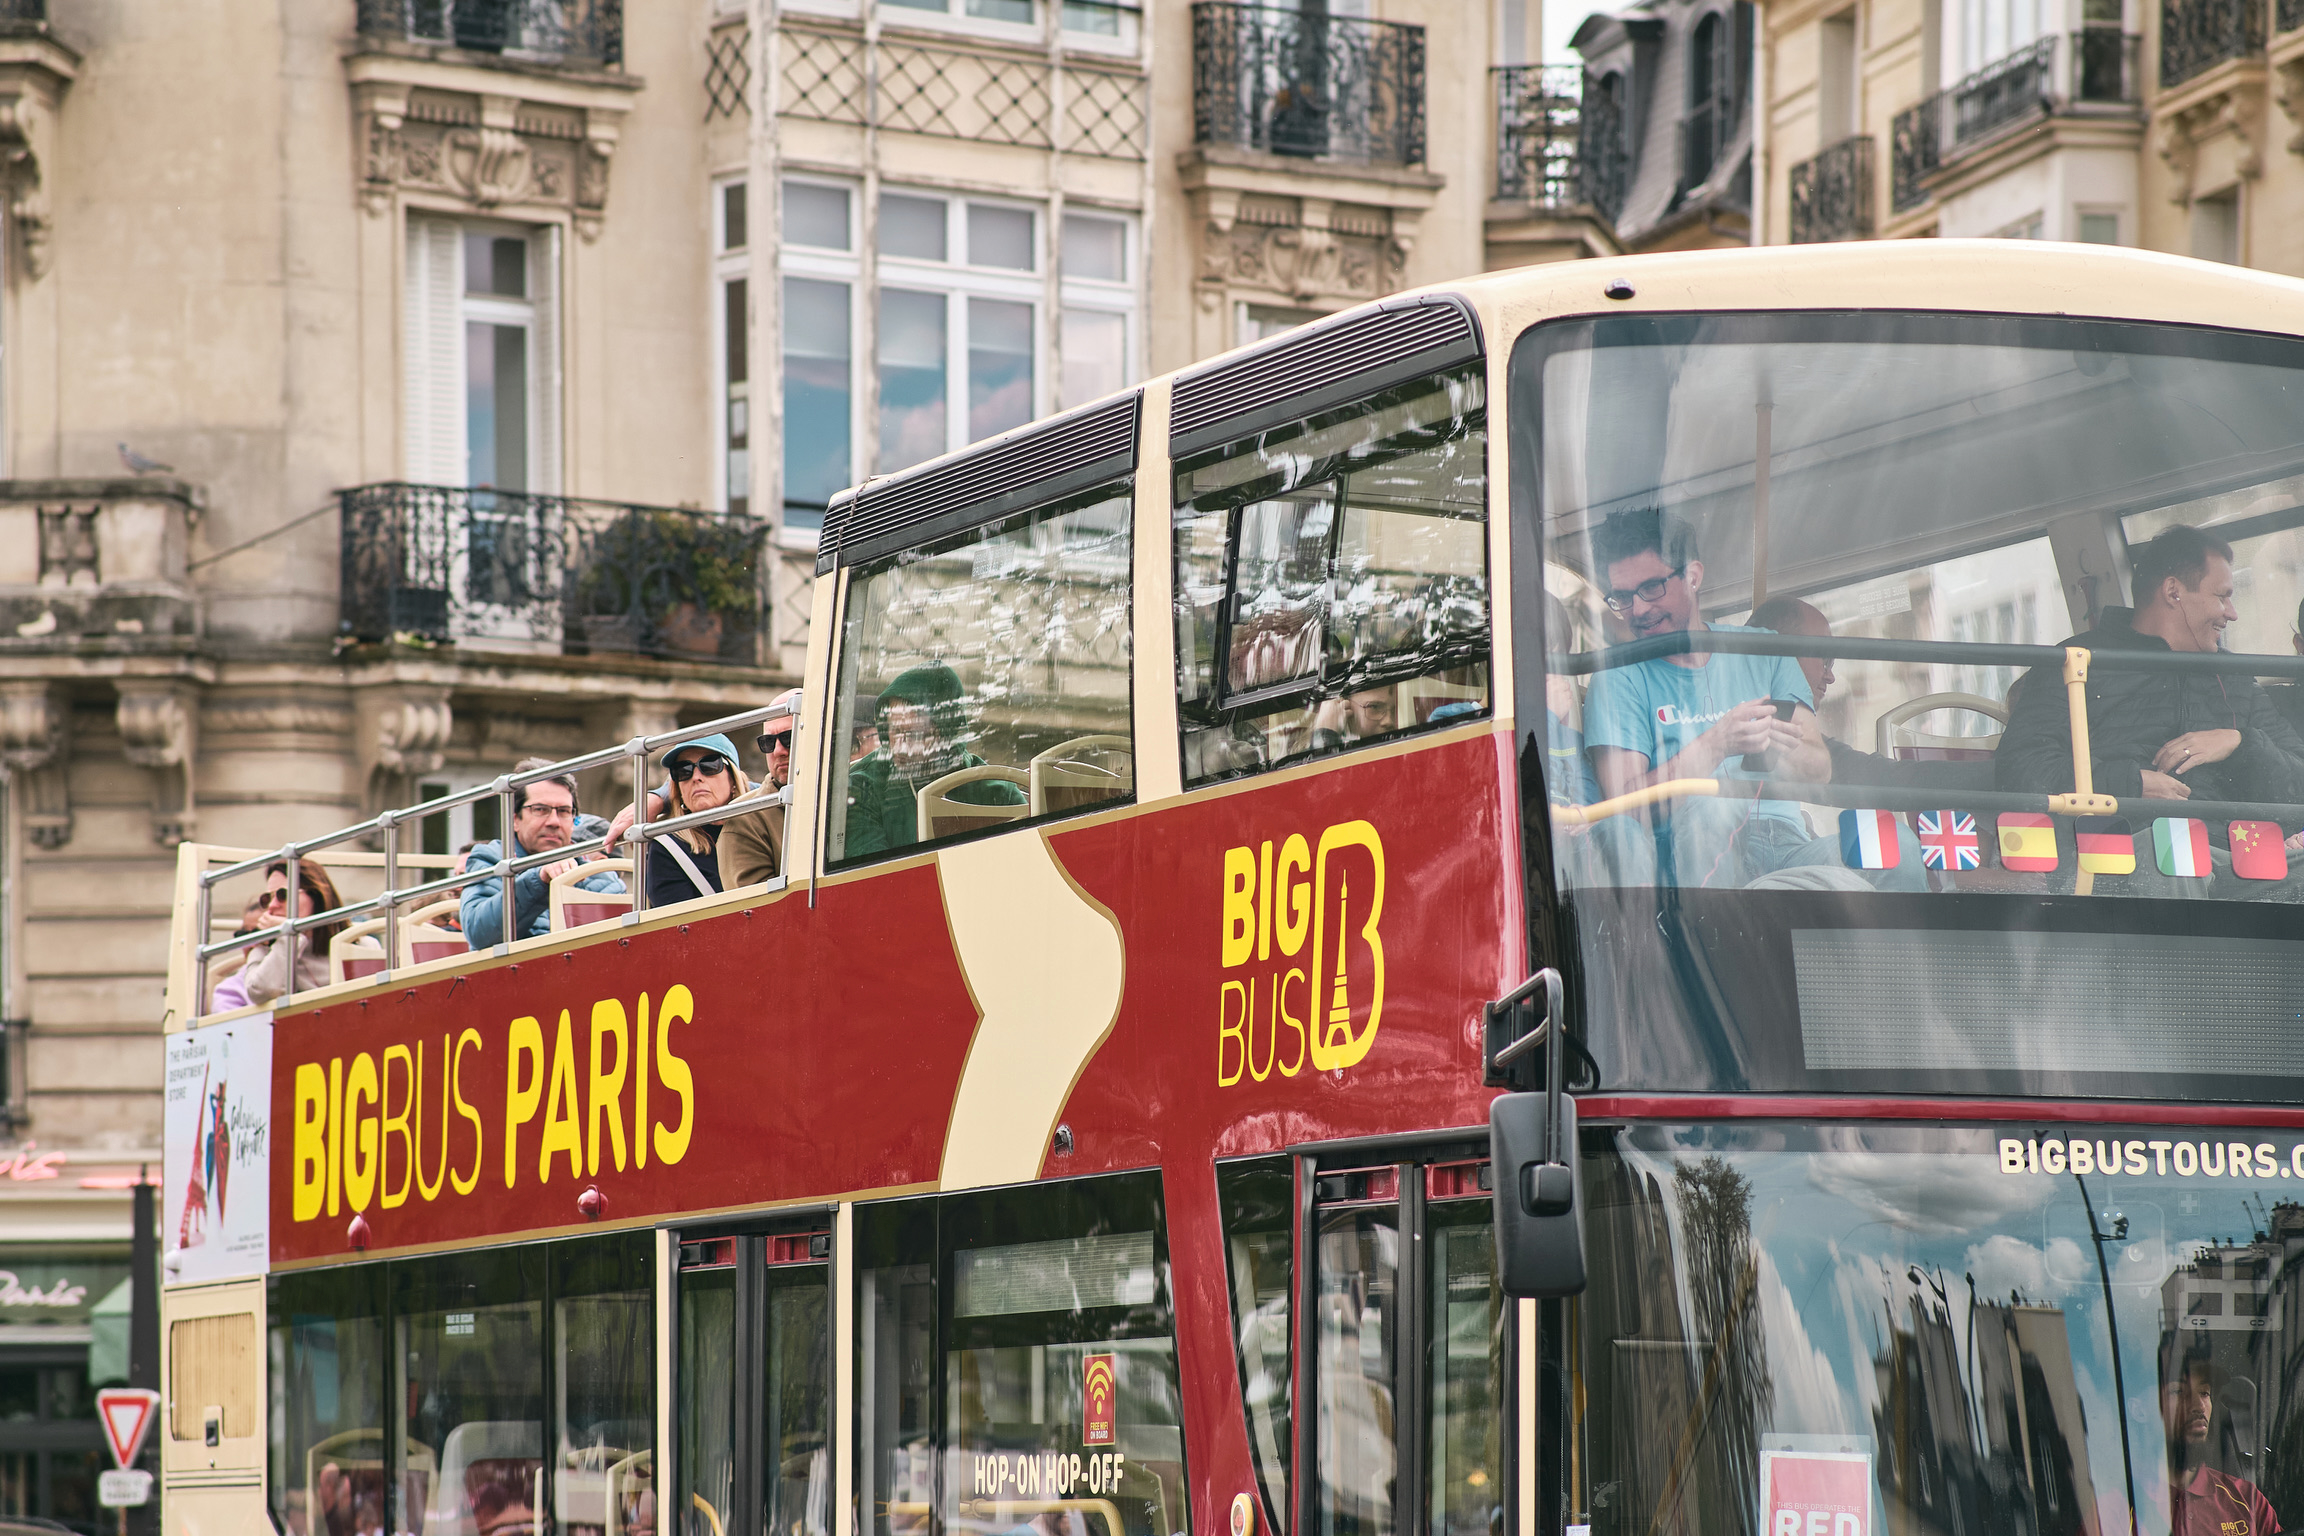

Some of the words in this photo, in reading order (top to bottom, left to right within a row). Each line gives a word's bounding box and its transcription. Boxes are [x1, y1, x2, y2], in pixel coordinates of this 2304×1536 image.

[1222, 833, 1311, 968] BIG
[1218, 967, 1306, 1087] BUS
[169, 1049, 180, 1063] THE
[169, 1086, 187, 1102] STORE
[504, 983, 694, 1189] PARIS
[1090, 1422, 1100, 1431] FREE
[974, 1454, 1040, 1495] HOP-ON
[1045, 1453, 1125, 1495] HOP-OFF
[1777, 1501, 1792, 1510] THIS
[1794, 1503, 1809, 1511] BUS
[1810, 1503, 1846, 1513] OPERATES
[1847, 1505, 1861, 1514] THE
[2220, 1521, 2235, 1531] BIG
